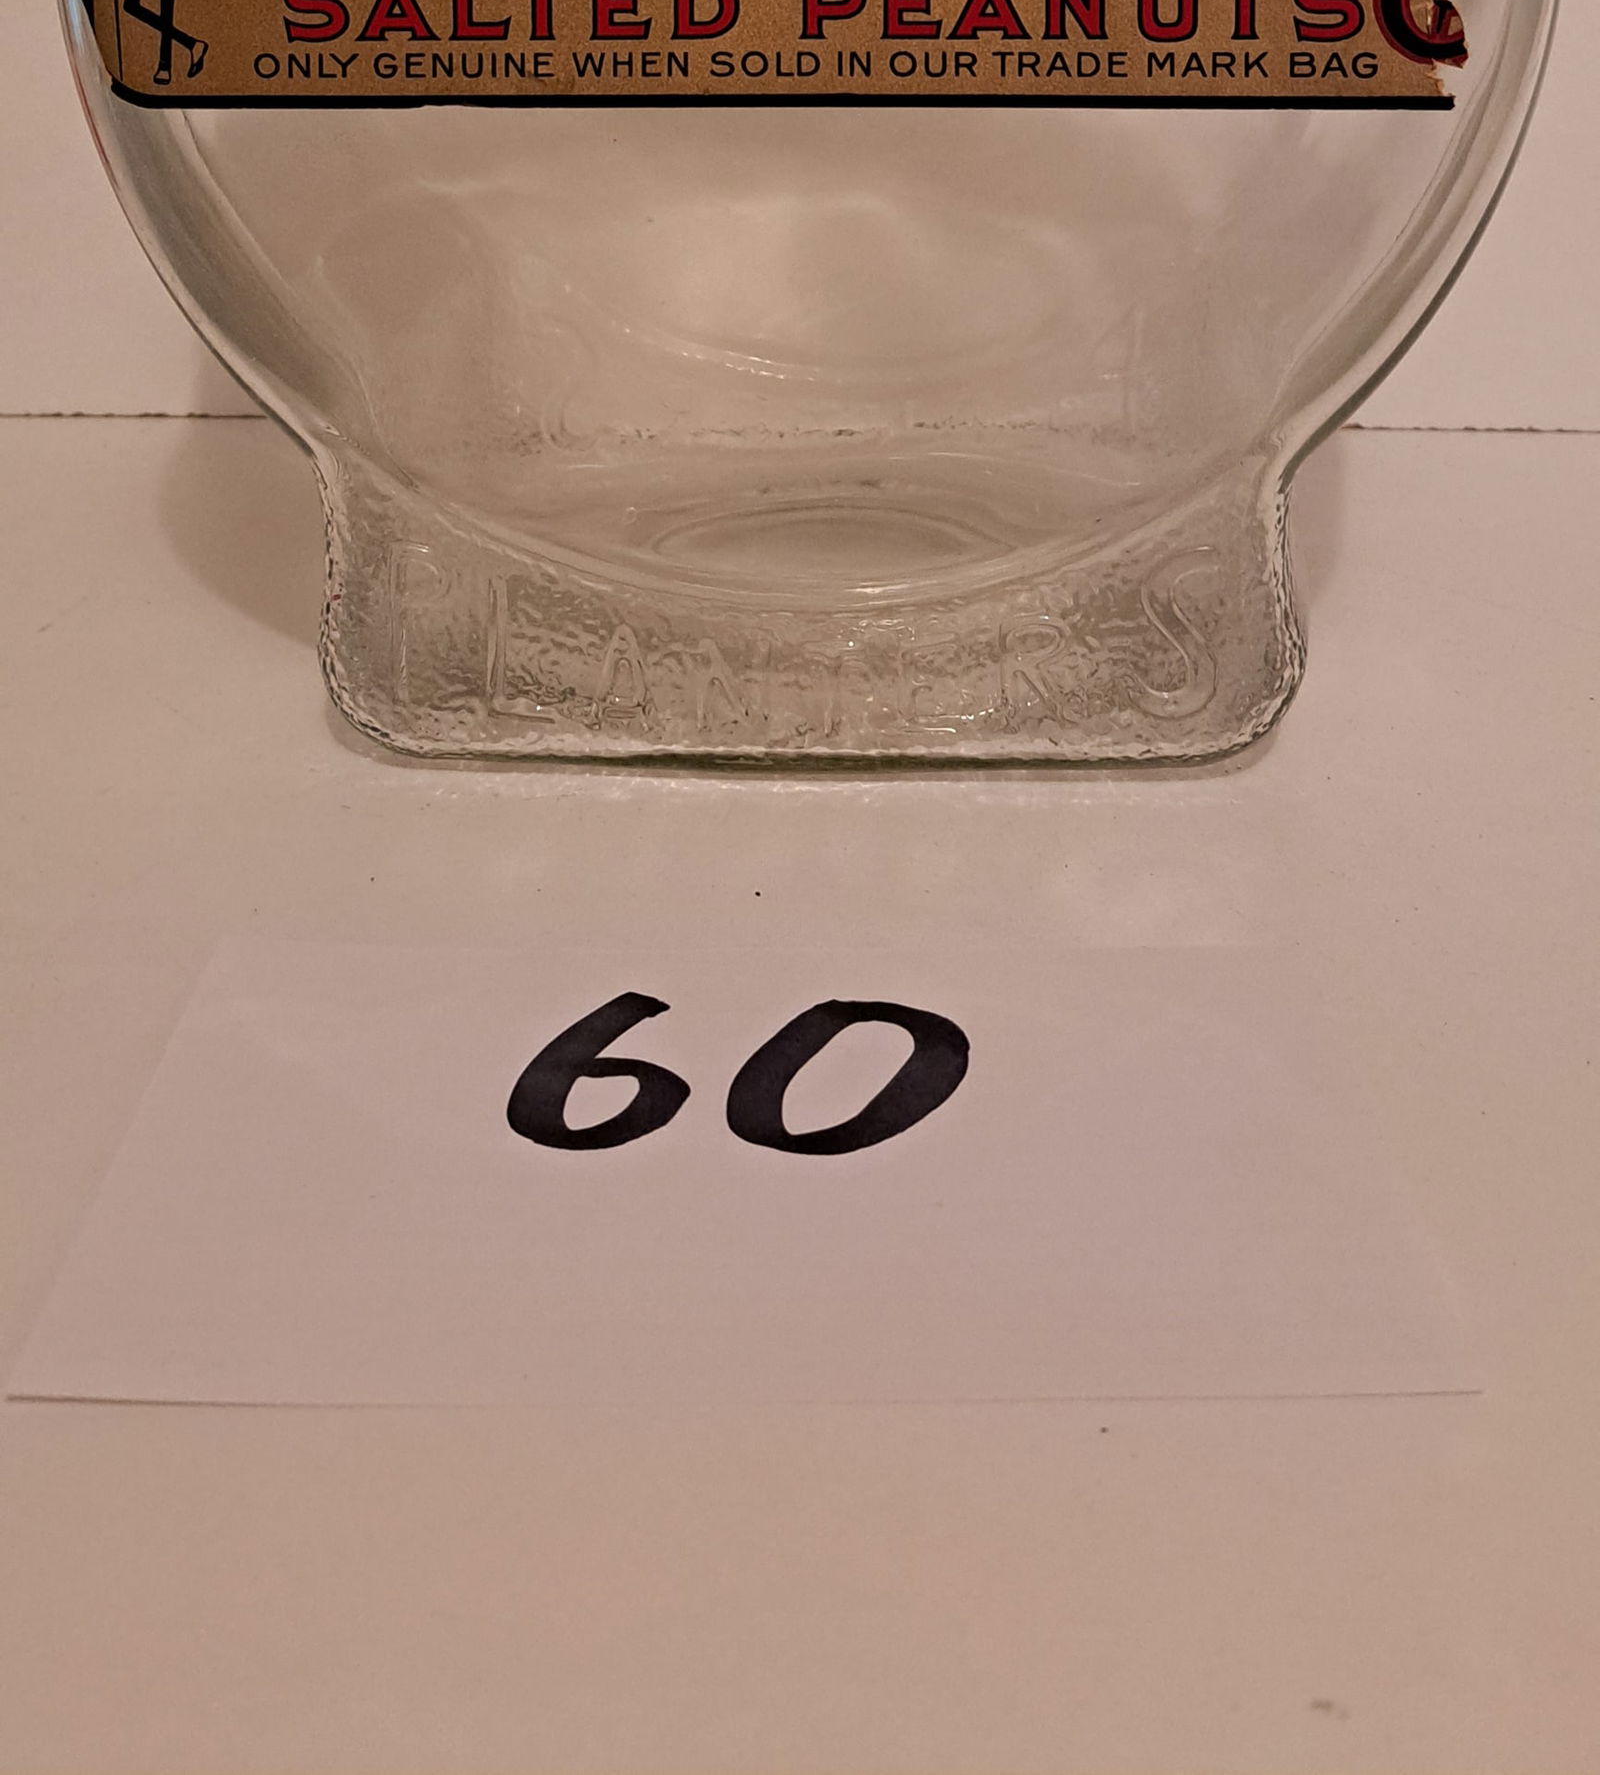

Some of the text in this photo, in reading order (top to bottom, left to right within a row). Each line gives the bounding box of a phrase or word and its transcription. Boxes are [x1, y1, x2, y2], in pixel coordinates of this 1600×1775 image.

[252, 50, 1379, 79] ONLY GENUINE WHEN SOLD IN OUR TRADE MARK BAG
[506, 991, 970, 1156] 60
